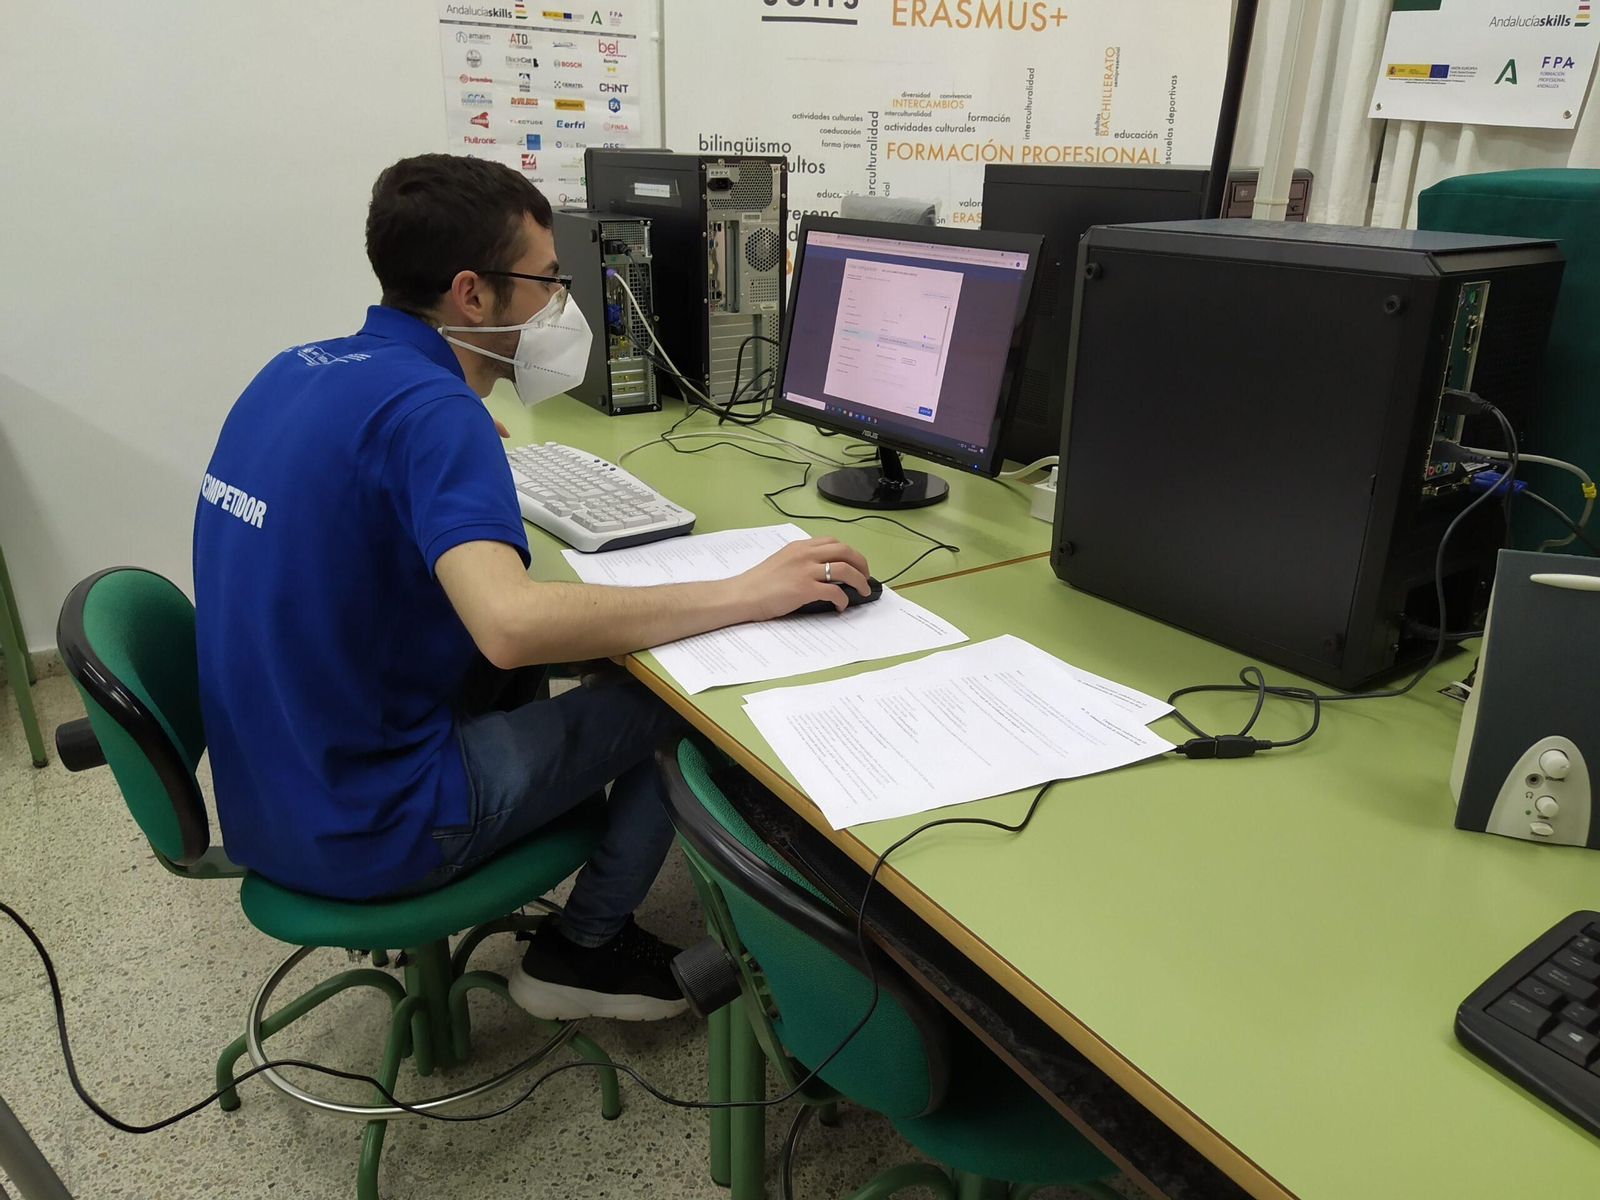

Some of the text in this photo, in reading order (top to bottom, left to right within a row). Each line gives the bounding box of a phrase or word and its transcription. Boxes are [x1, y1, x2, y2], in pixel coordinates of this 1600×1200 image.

[892, 0, 1068, 32] ERASMUS+
[1489, 14, 1571, 27] Andalucíaskills
[598, 38, 619, 54] bel
[901, 91, 931, 99] diversidad
[1100, 46, 1116, 137] BACHILLERATO
[892, 99, 965, 110] INTERCAMBIOS
[1023, 67, 1035, 140] interculturalidad
[1165, 74, 1178, 125] deportivas
[791, 113, 864, 123] actividades culturales
[884, 109, 932, 118] interculturalidad
[967, 112, 1011, 123] formación
[819, 127, 862, 136] coeducación
[884, 123, 976, 134] actividades culturales
[1093, 113, 1101, 137] adultos
[1114, 130, 1159, 140] educación
[699, 133, 792, 155] bilingüismo
[821, 140, 862, 150] forma joven
[866, 111, 879, 196] erculturalidad
[886, 138, 1160, 165] FORMACIÓN PROFESIONAL
[787, 155, 826, 175] ultos
